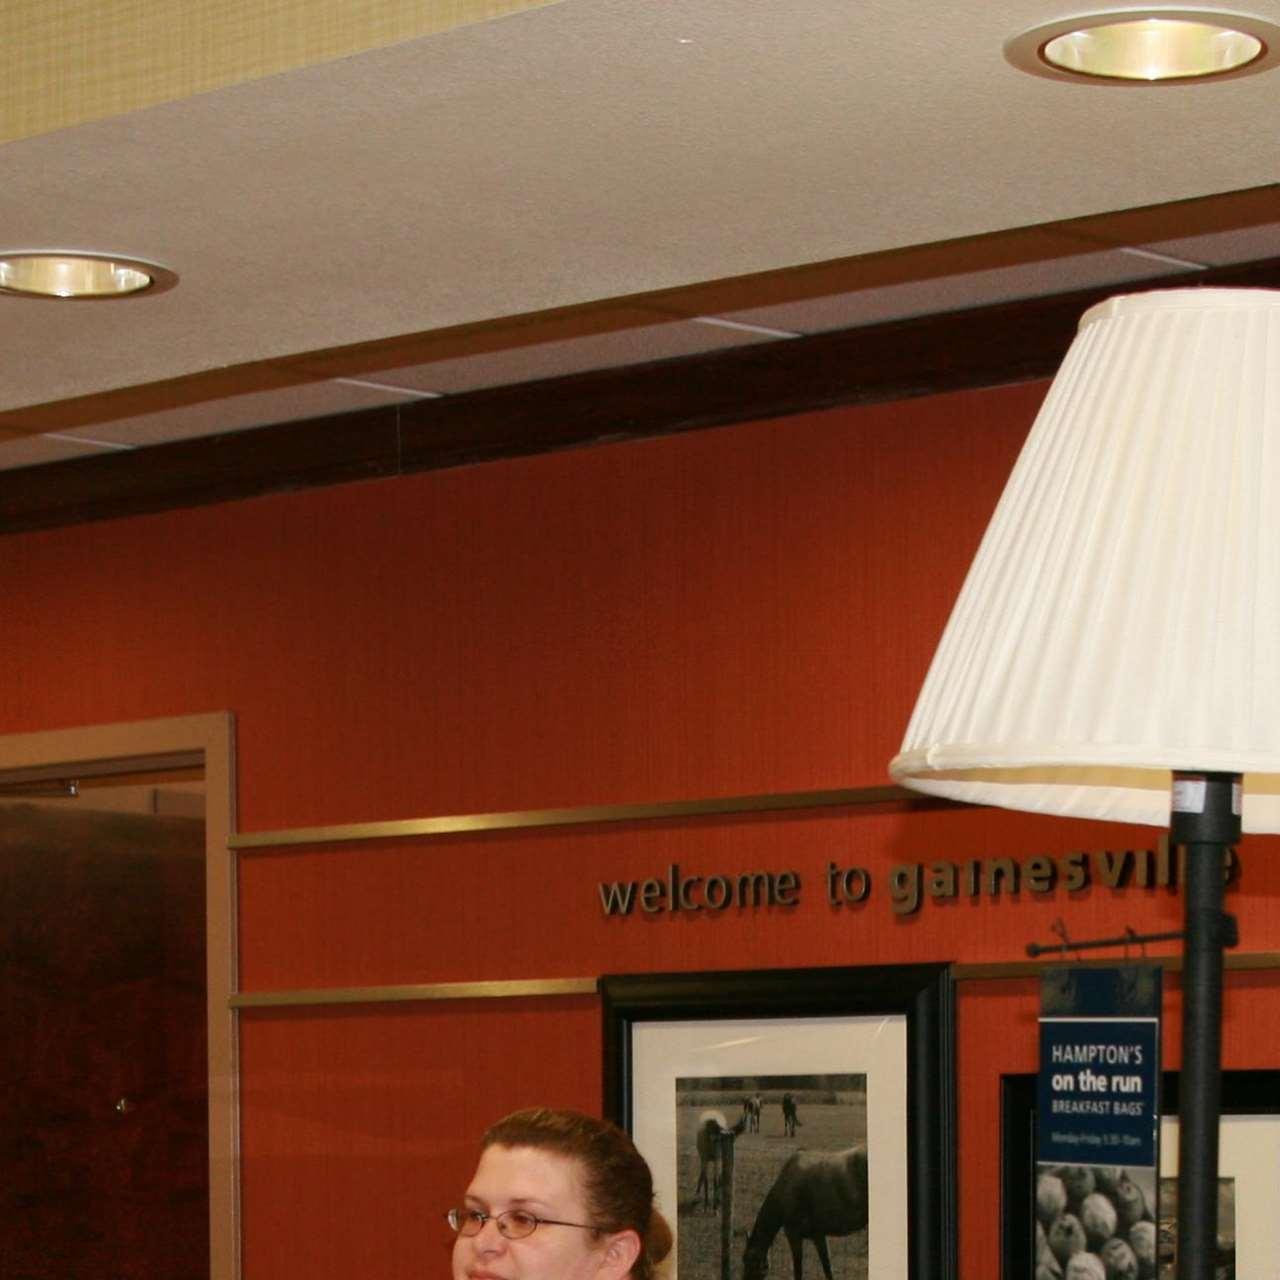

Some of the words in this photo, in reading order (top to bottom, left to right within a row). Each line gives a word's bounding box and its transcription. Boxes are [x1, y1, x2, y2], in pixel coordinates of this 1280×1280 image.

[598, 863, 801, 915] welcome
[827, 861, 872, 906] to
[1051, 1044, 1143, 1064] HAMPTON'S
[1051, 1073, 1074, 1091] on
[1078, 1068, 1107, 1092] the
[1111, 1074, 1142, 1093] run
[1051, 1099, 1110, 1115] BREAKFAST
